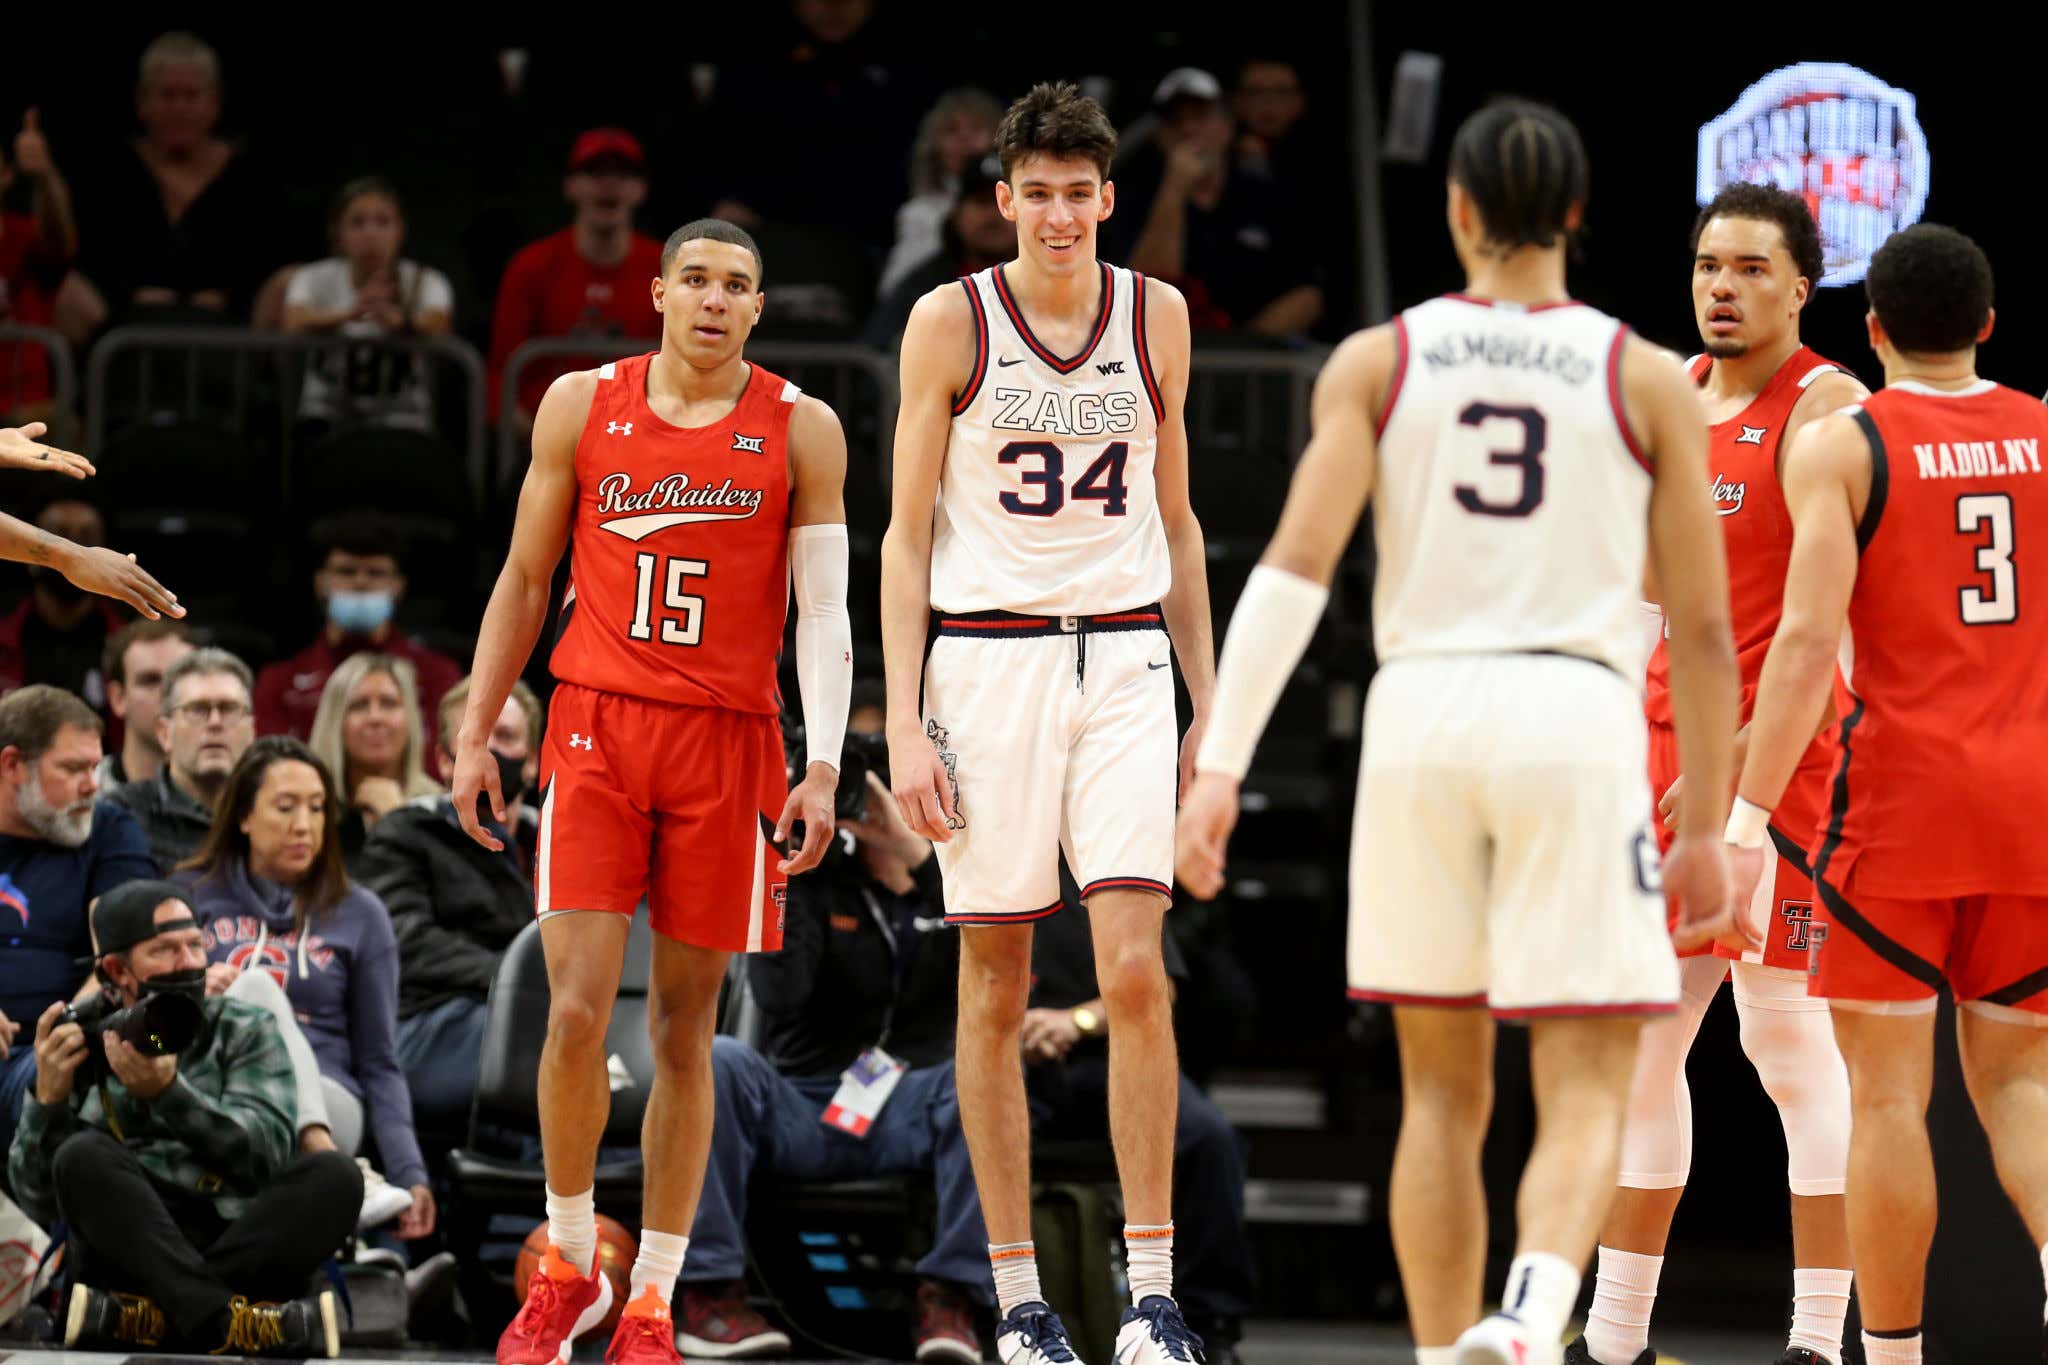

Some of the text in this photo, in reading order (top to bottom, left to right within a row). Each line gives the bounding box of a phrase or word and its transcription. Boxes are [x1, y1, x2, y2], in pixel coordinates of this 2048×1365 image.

[1096, 360, 1126, 377] WCC
[992, 387, 1138, 435] ZAGS
[998, 441, 1130, 517] 34
[1453, 401, 1547, 520] 3
[1913, 438, 2042, 479] NADOLNY
[1956, 491, 2018, 626] 3
[628, 552, 710, 646] 15
